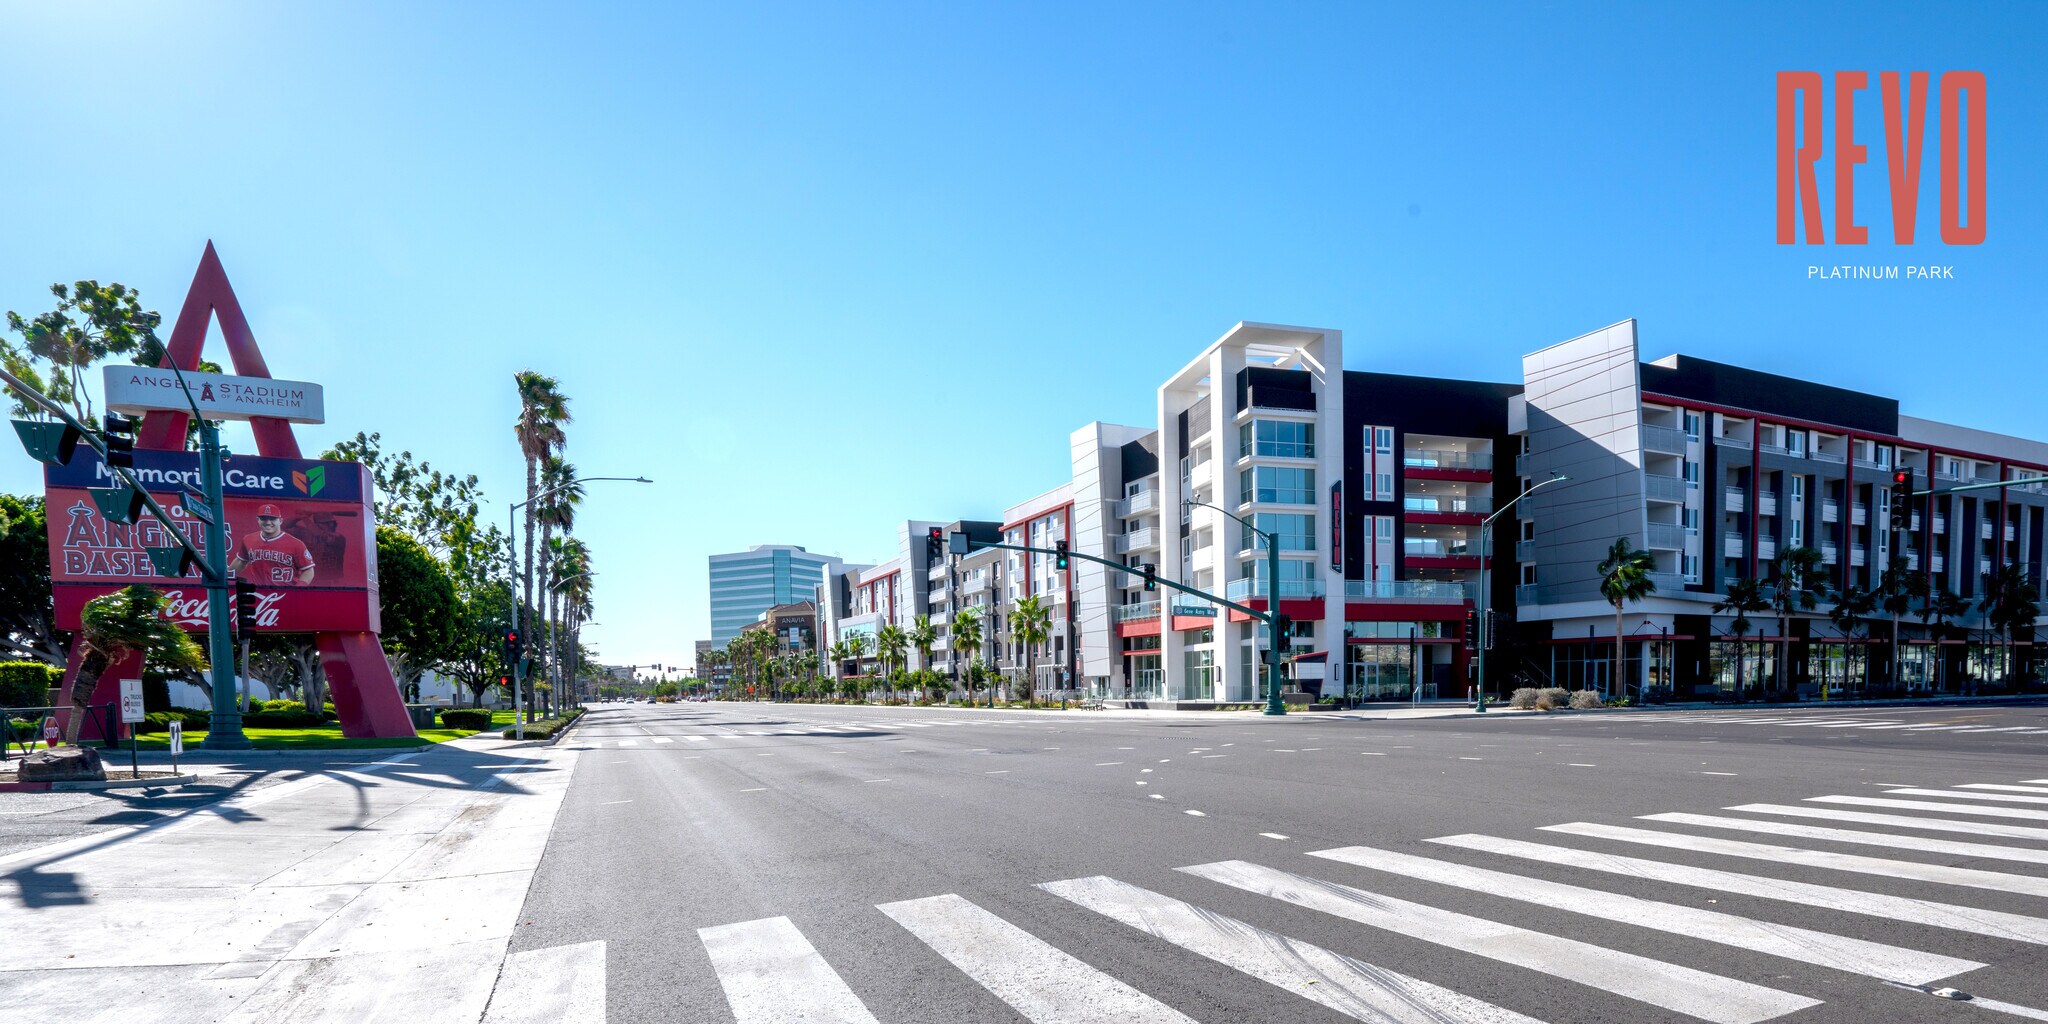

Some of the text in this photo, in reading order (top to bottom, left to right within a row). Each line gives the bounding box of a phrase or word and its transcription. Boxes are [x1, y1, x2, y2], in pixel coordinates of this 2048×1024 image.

[129, 375, 199, 391] ANGEL
[220, 383, 304, 400] STADIUM
[235, 396, 301, 408] ANAHEIM
[96, 461, 284, 490] MmorilCare
[64, 550, 236, 577] BASE
[271, 566, 294, 582] 27
[162, 590, 287, 627] Cocala
[45, 726, 59, 739] STOP
